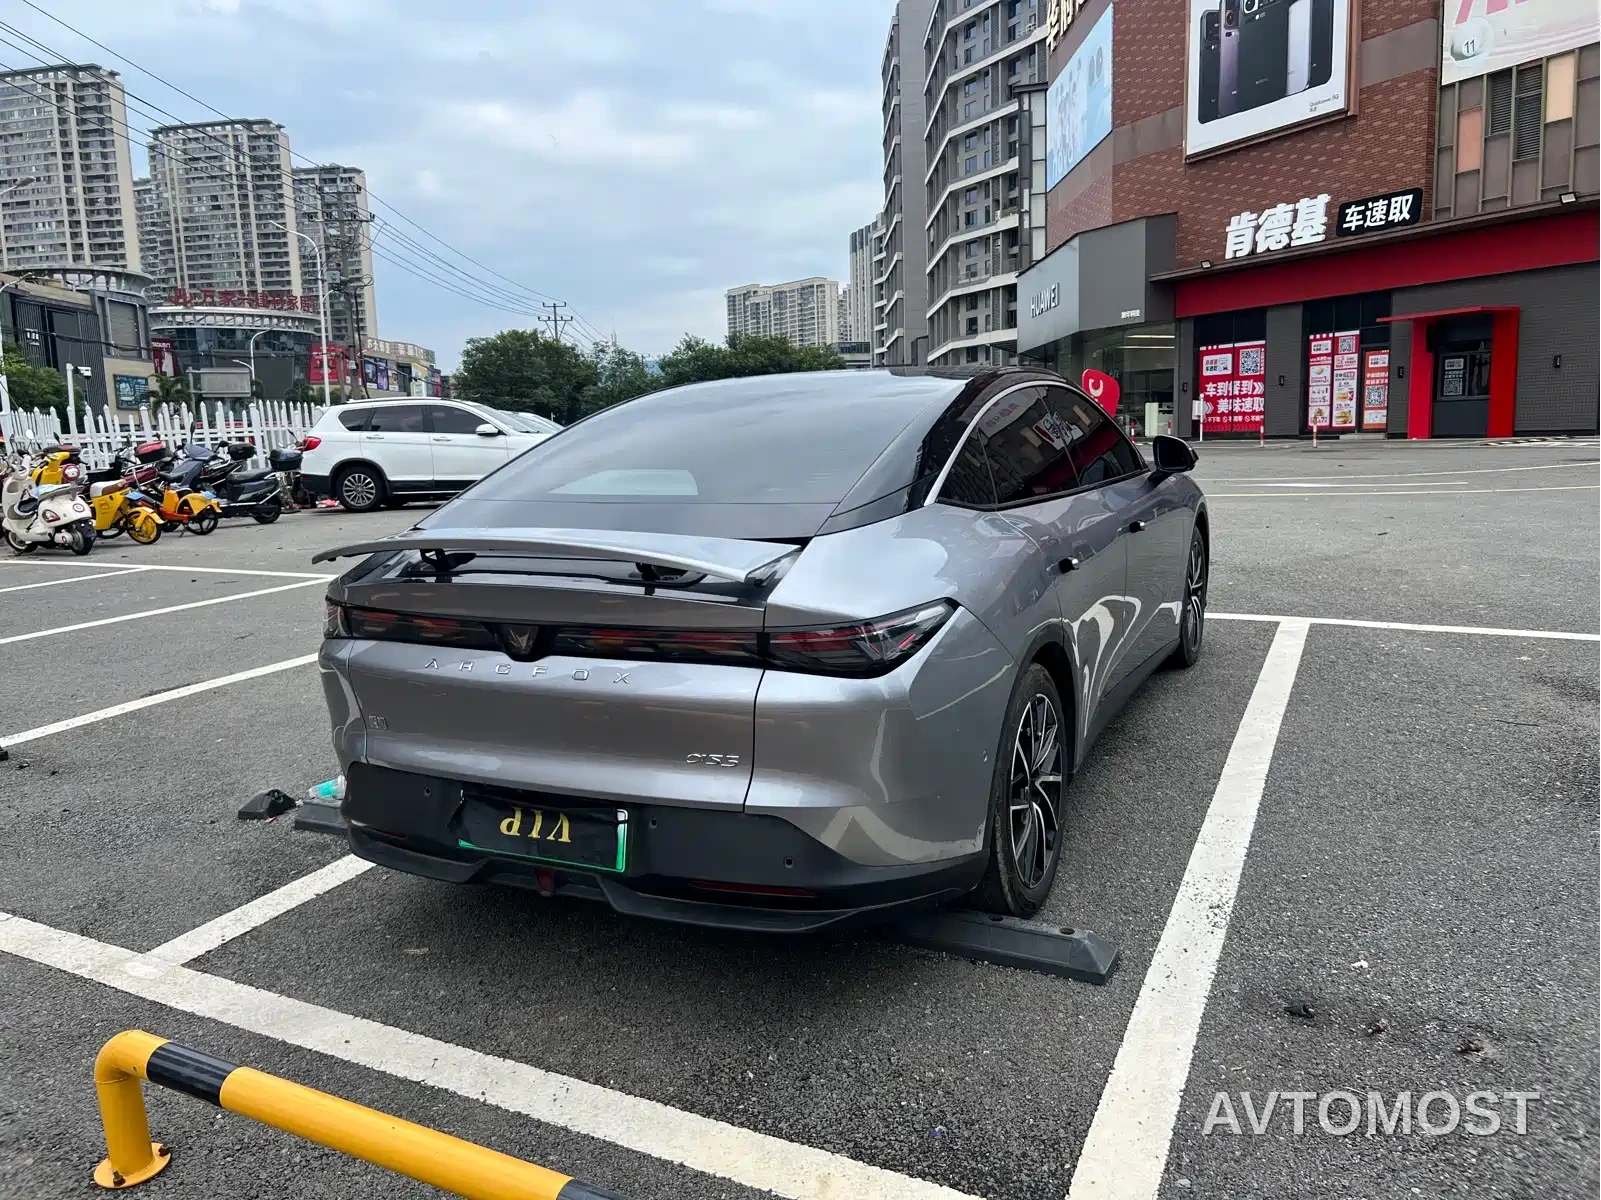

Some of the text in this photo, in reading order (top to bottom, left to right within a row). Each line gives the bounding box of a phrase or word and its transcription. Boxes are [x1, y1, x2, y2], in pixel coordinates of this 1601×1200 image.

[1464, 39, 1476, 54] 11
[1224, 193, 1414, 260] 肯德基 车速取
[1030, 282, 1060, 319] HUAWEI
[1204, 379, 1254, 398] 车到餐到
[1216, 396, 1265, 414] 美味速取
[424, 658, 631, 685] ARCFOX
[500, 806, 572, 843] VIP
